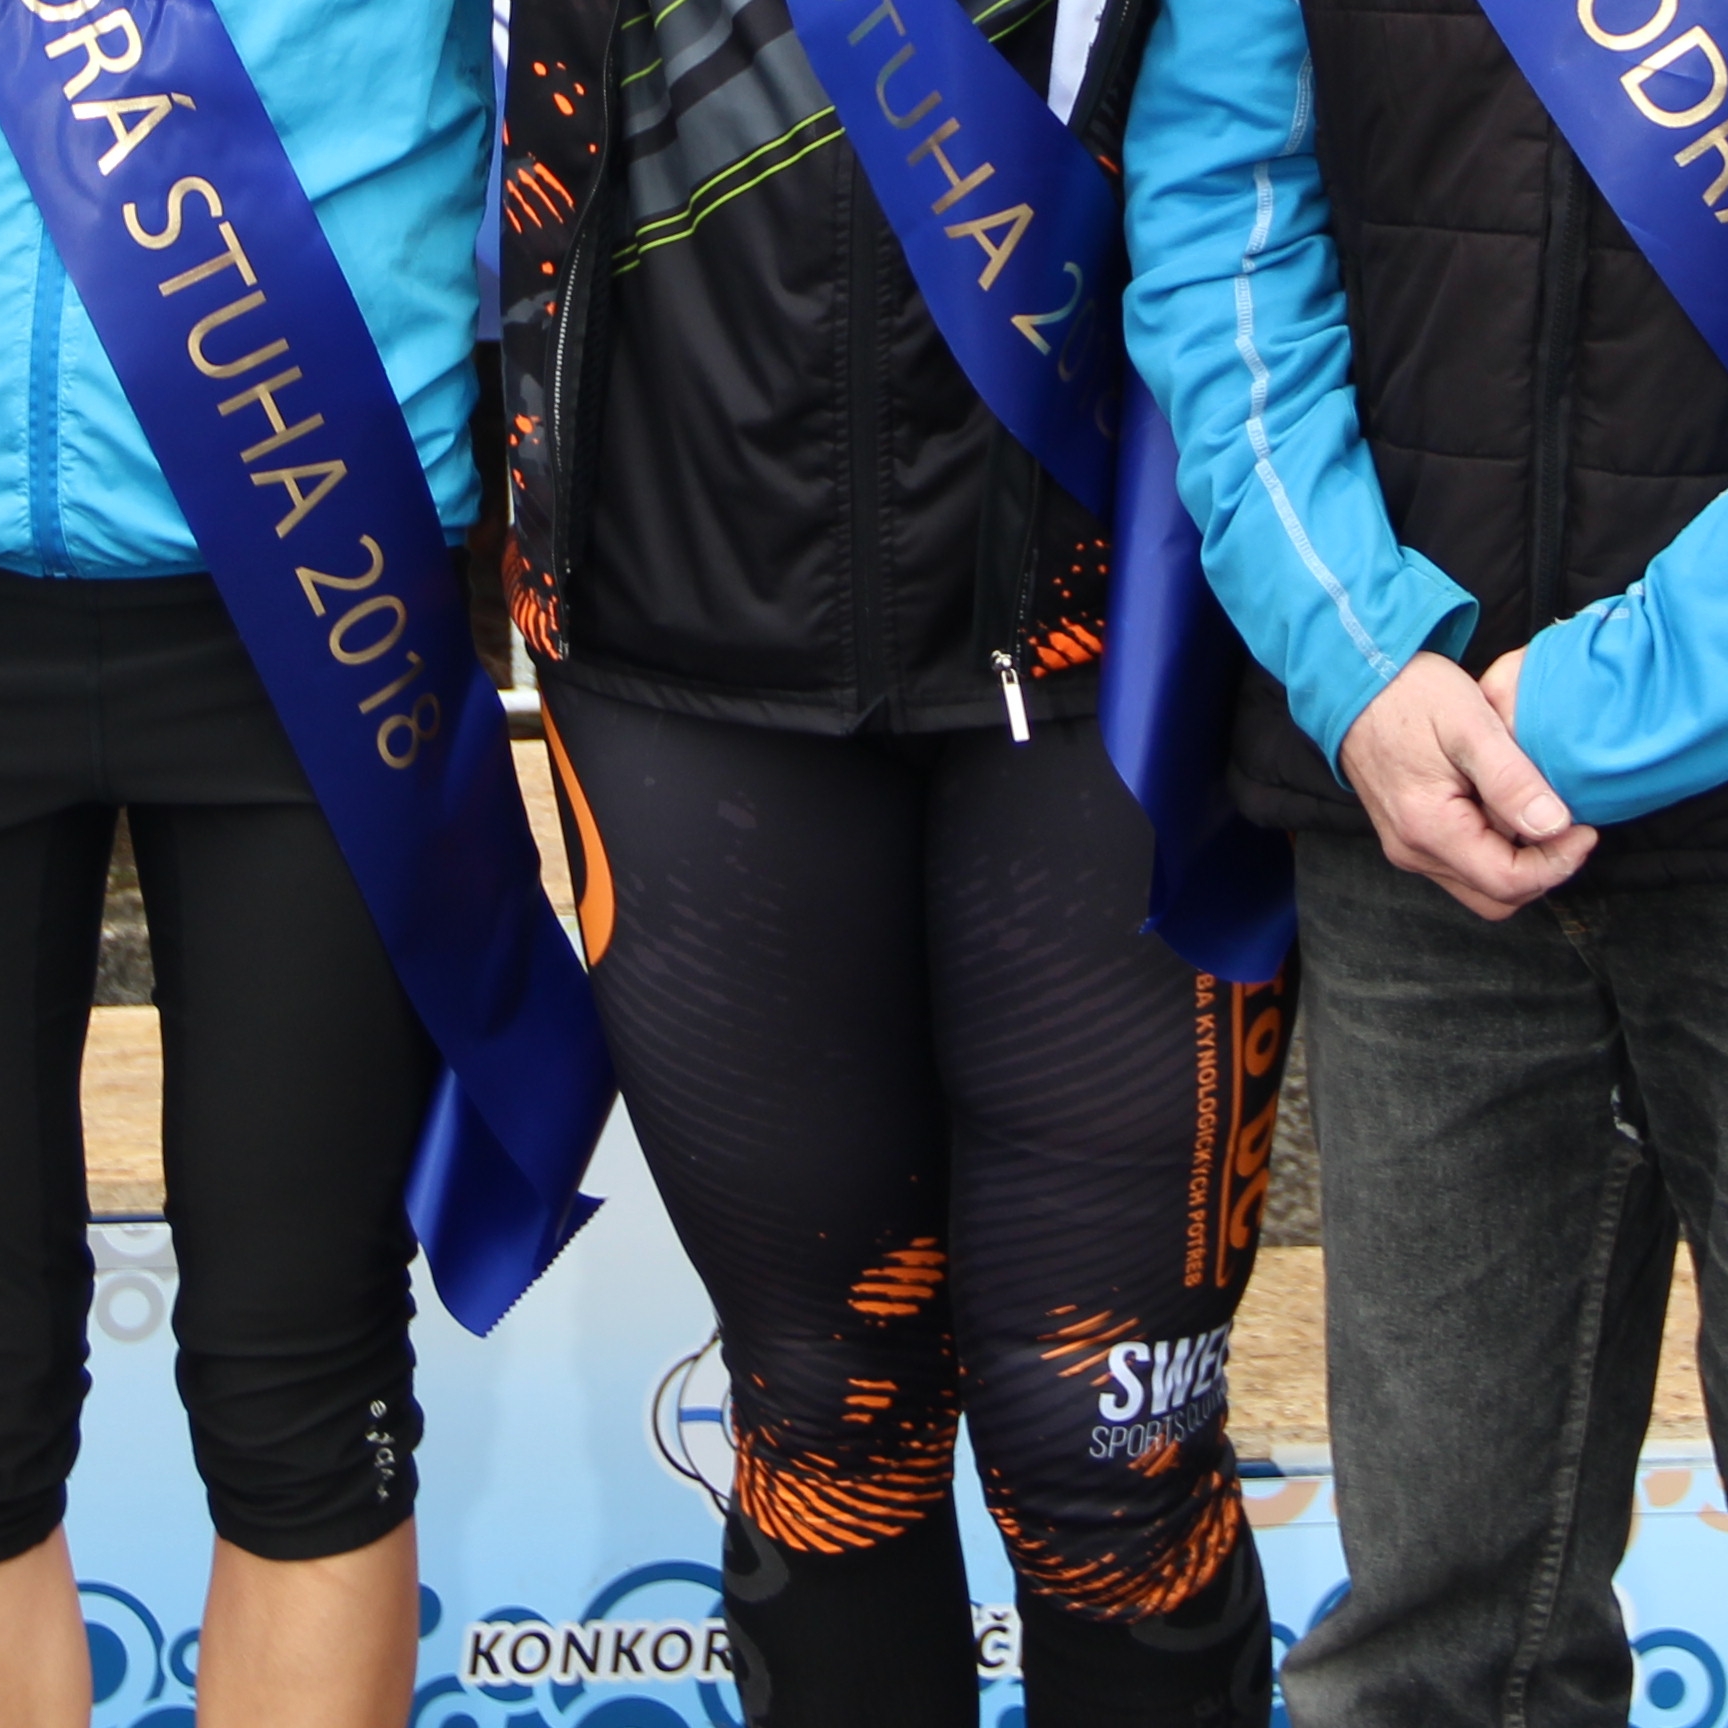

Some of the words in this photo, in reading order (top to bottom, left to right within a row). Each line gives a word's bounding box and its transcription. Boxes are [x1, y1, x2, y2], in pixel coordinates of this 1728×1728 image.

[122, 175, 349, 539] STUHA
[294, 534, 442, 770] 2018
[1088, 1408, 1186, 1460] SPORTS
